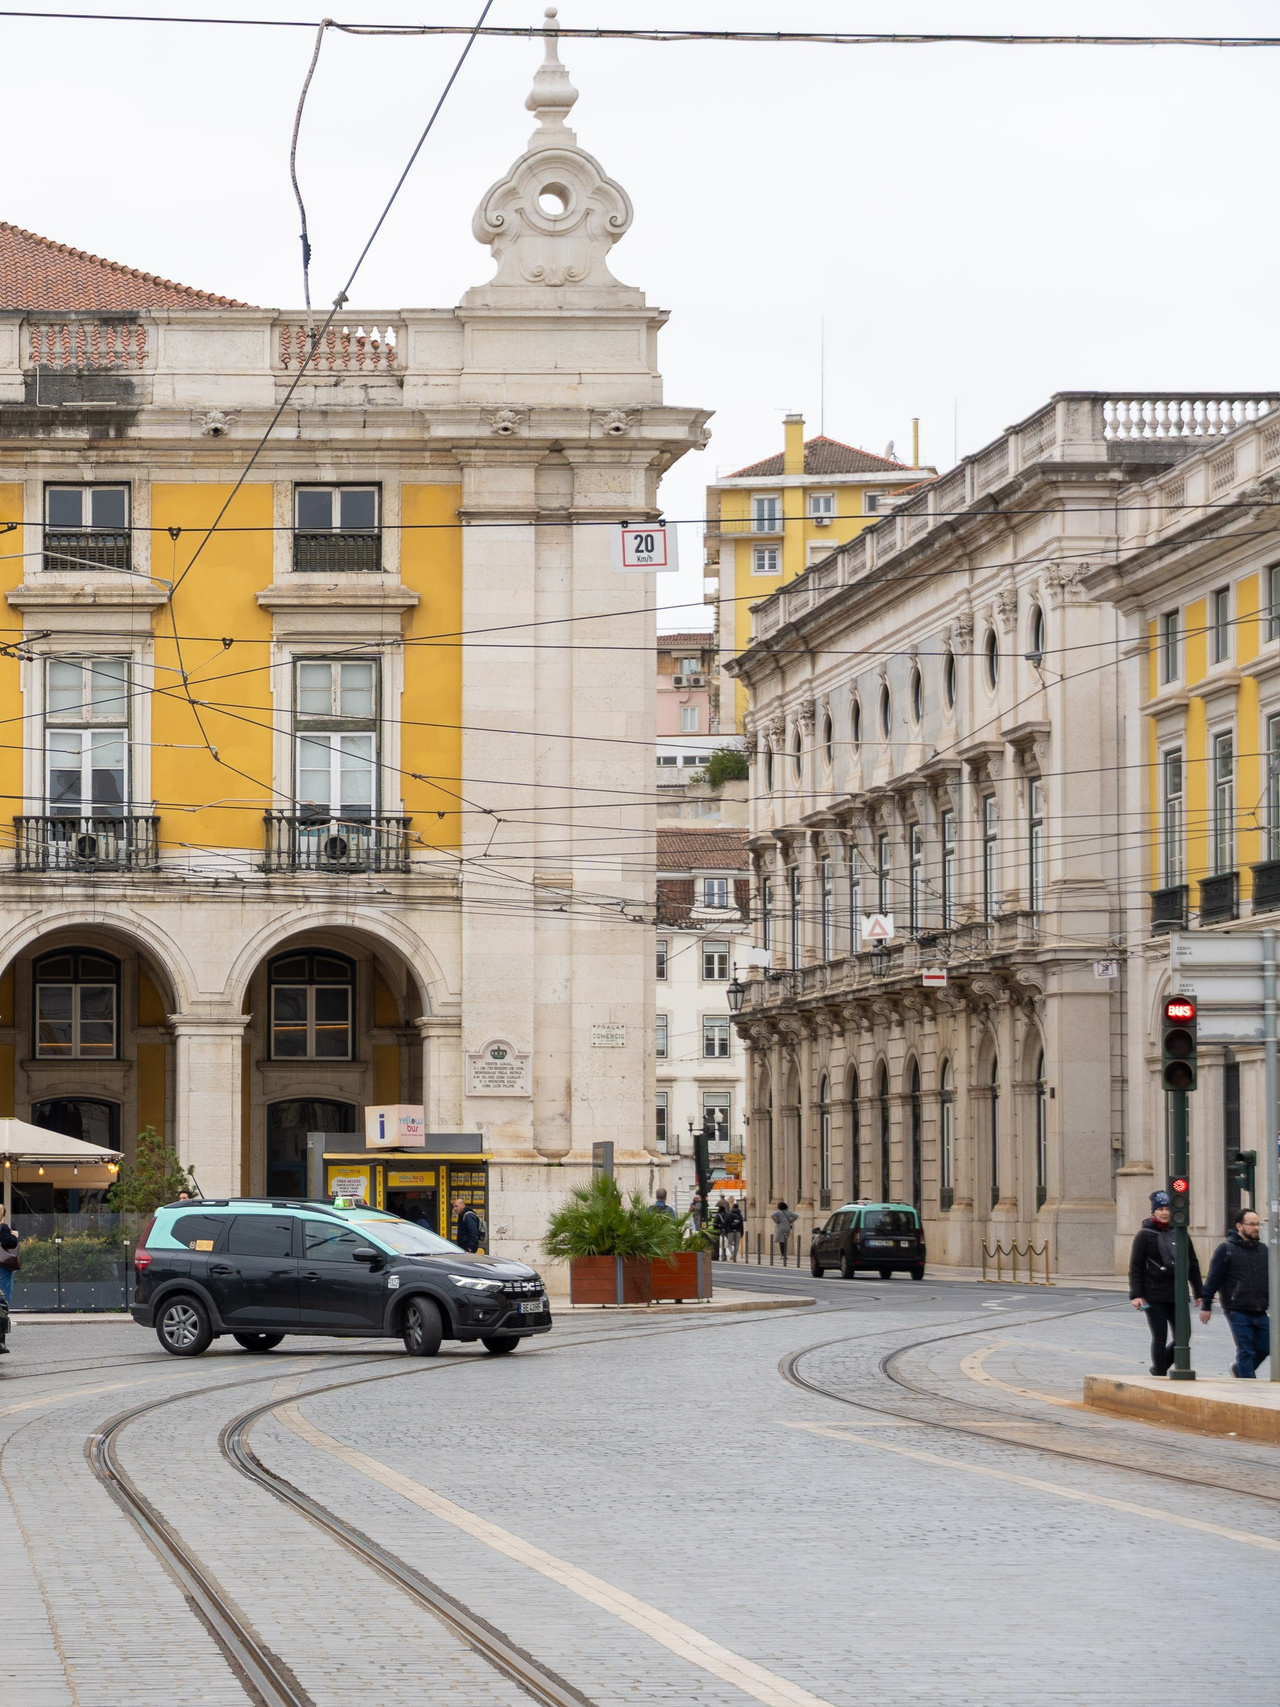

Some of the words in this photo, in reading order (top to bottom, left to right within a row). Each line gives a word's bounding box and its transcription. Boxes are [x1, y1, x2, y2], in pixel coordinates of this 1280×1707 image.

[634, 534, 654, 553] 20
[637, 555, 653, 563] Km/h
[1168, 1005, 1191, 1016] BUS
